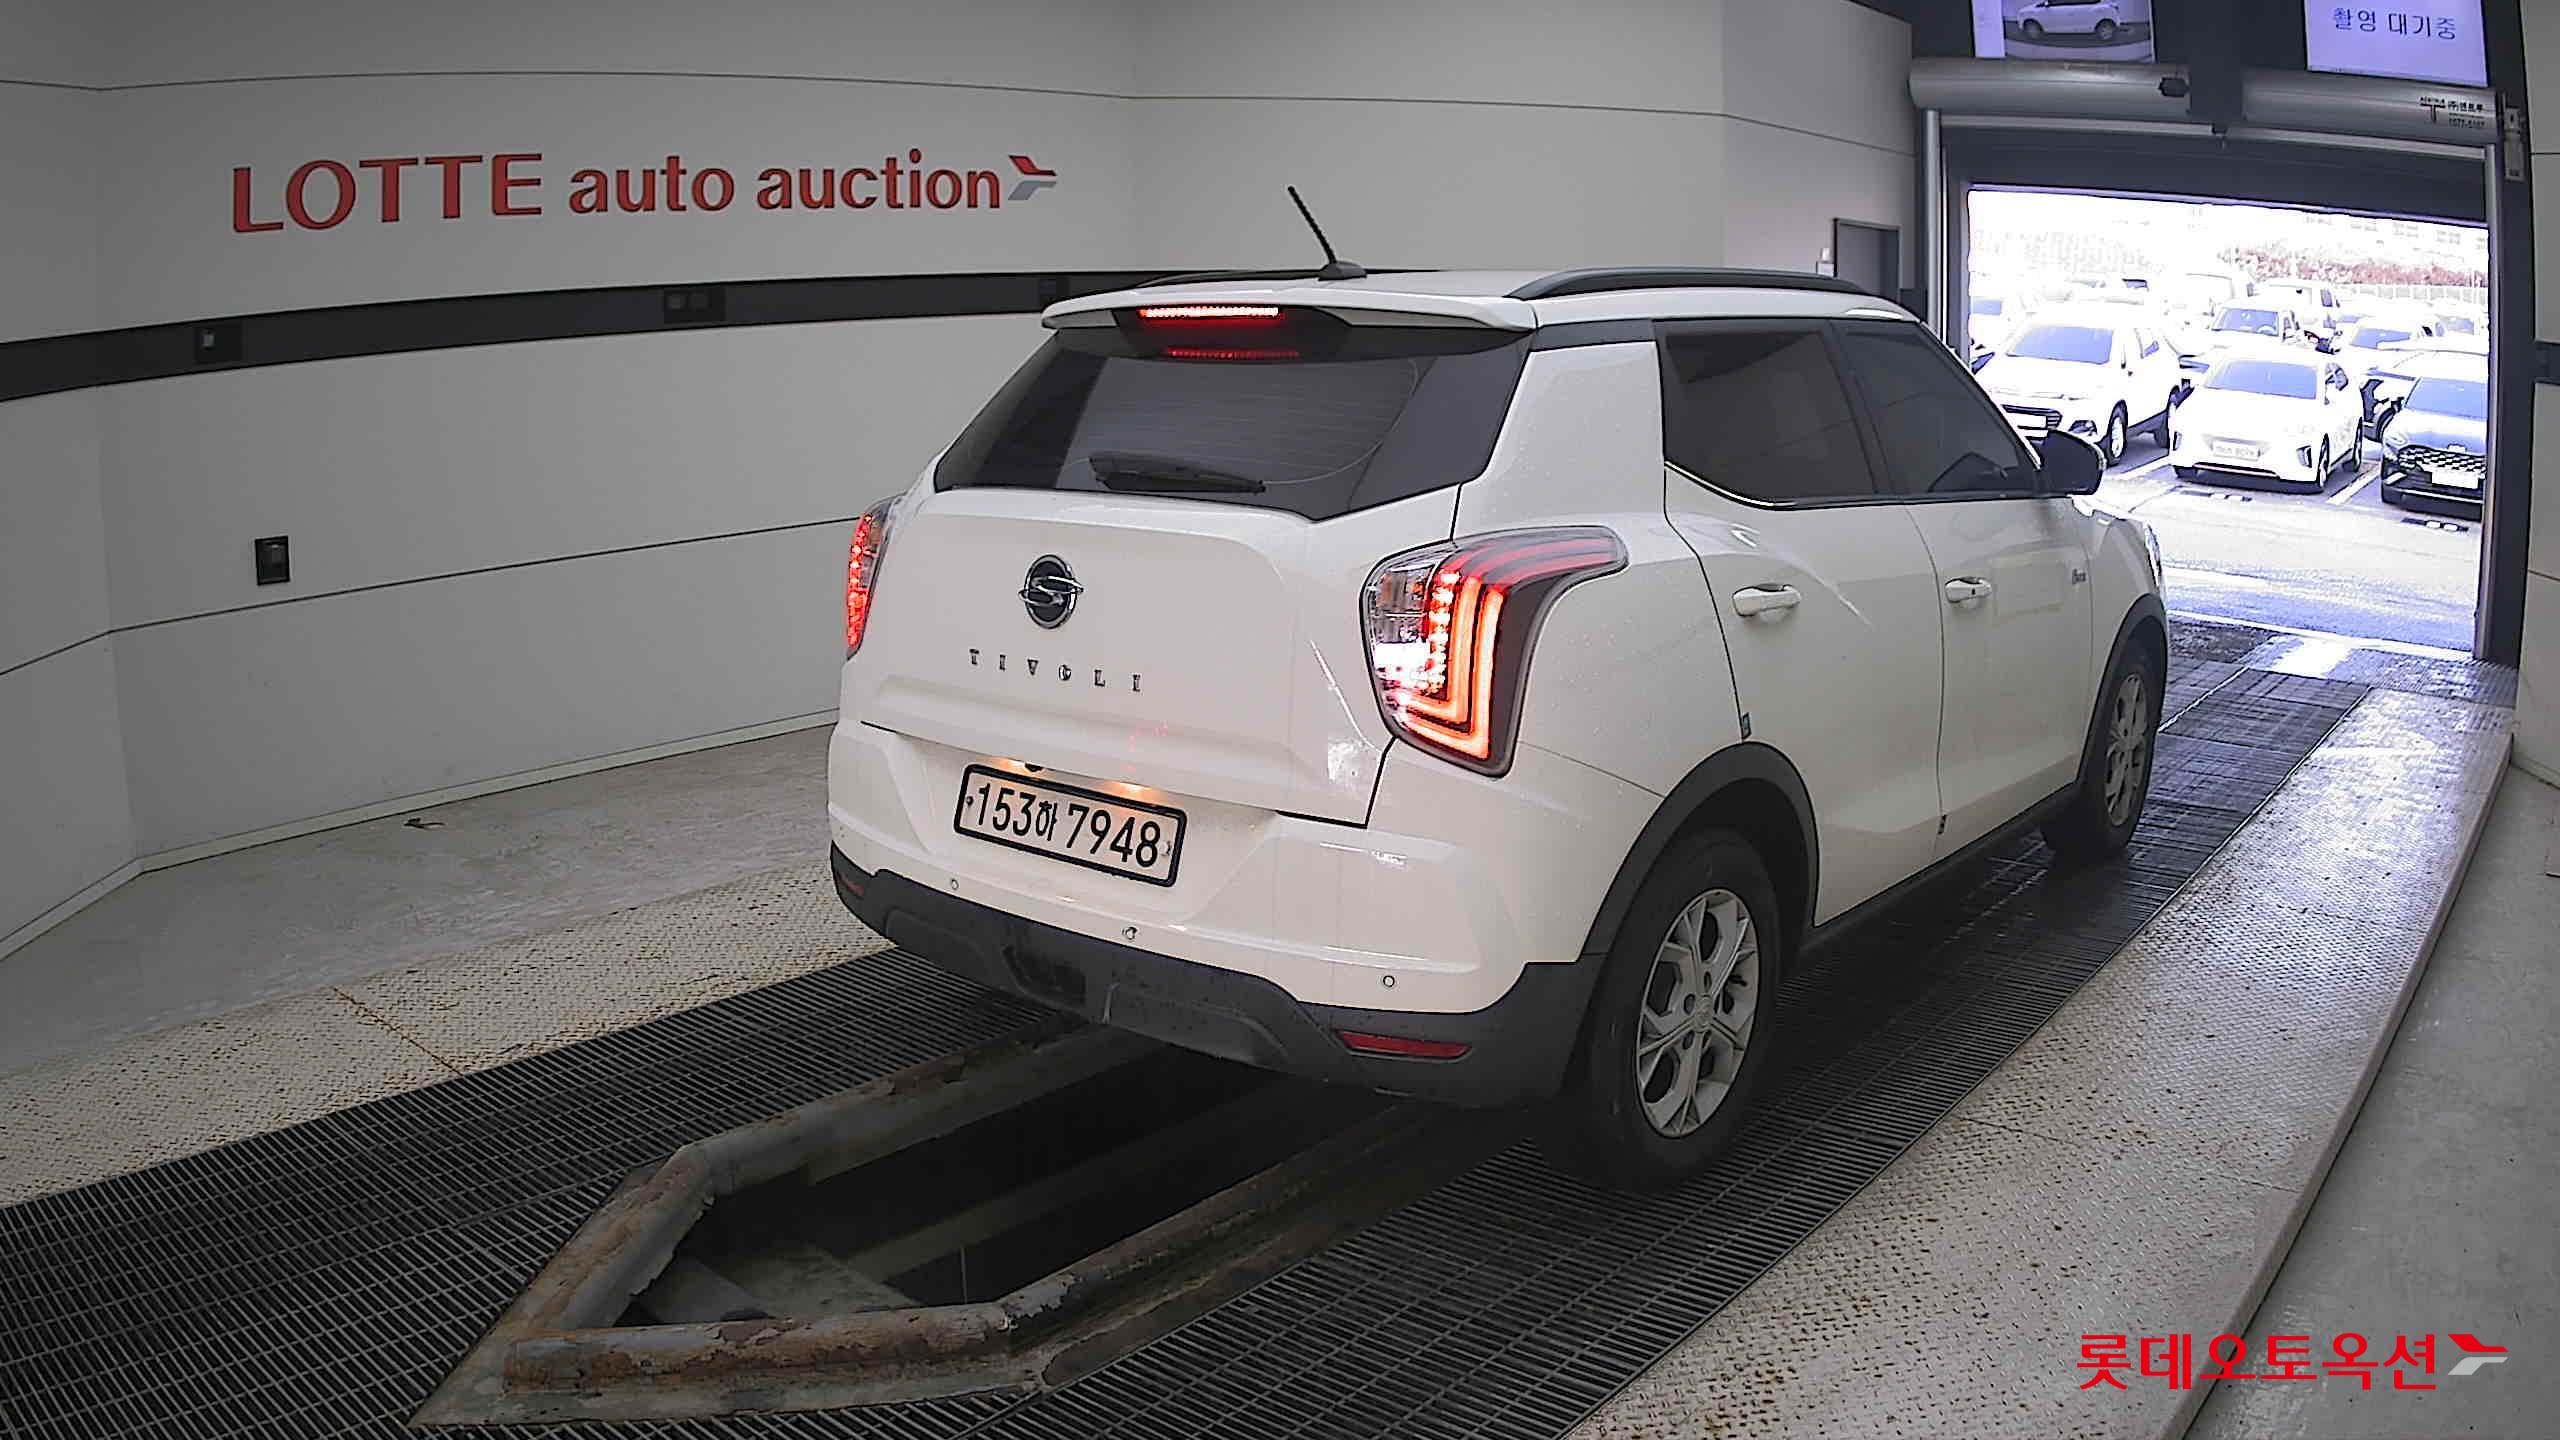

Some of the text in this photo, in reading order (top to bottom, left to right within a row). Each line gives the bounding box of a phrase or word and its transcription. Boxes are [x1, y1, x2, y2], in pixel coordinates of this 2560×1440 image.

[2333, 7, 2456, 40] 촬영 대기중
[232, 147, 1002, 234] LOTTE auto auction
[968, 647, 1142, 693] TIVOLI
